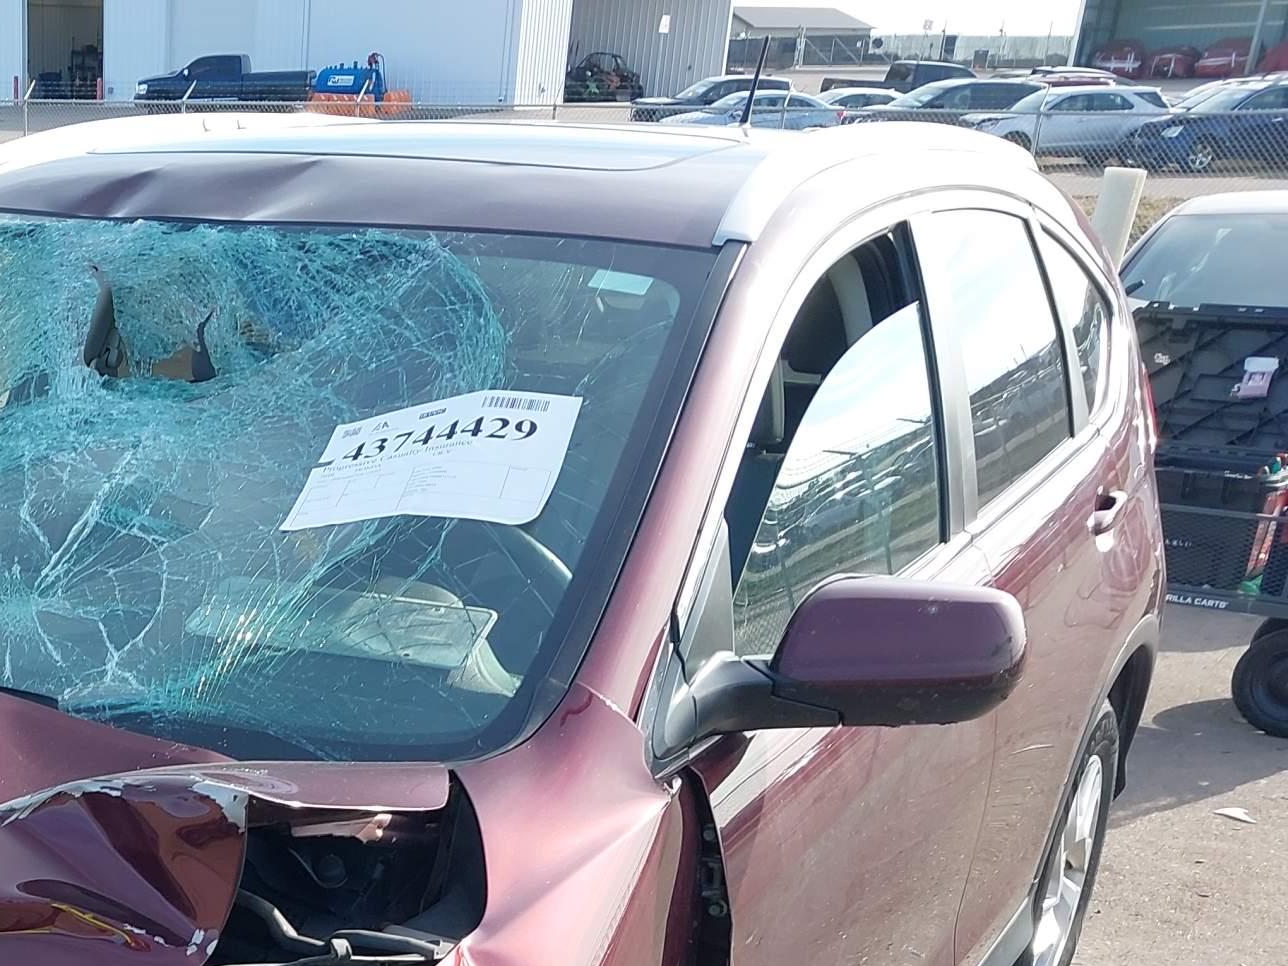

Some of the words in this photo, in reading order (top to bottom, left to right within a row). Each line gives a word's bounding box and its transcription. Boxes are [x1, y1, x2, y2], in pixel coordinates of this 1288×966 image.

[341, 416, 538, 461] 43744429
[424, 440, 474, 454] Insurance
[1165, 593, 1192, 605] RILLA
